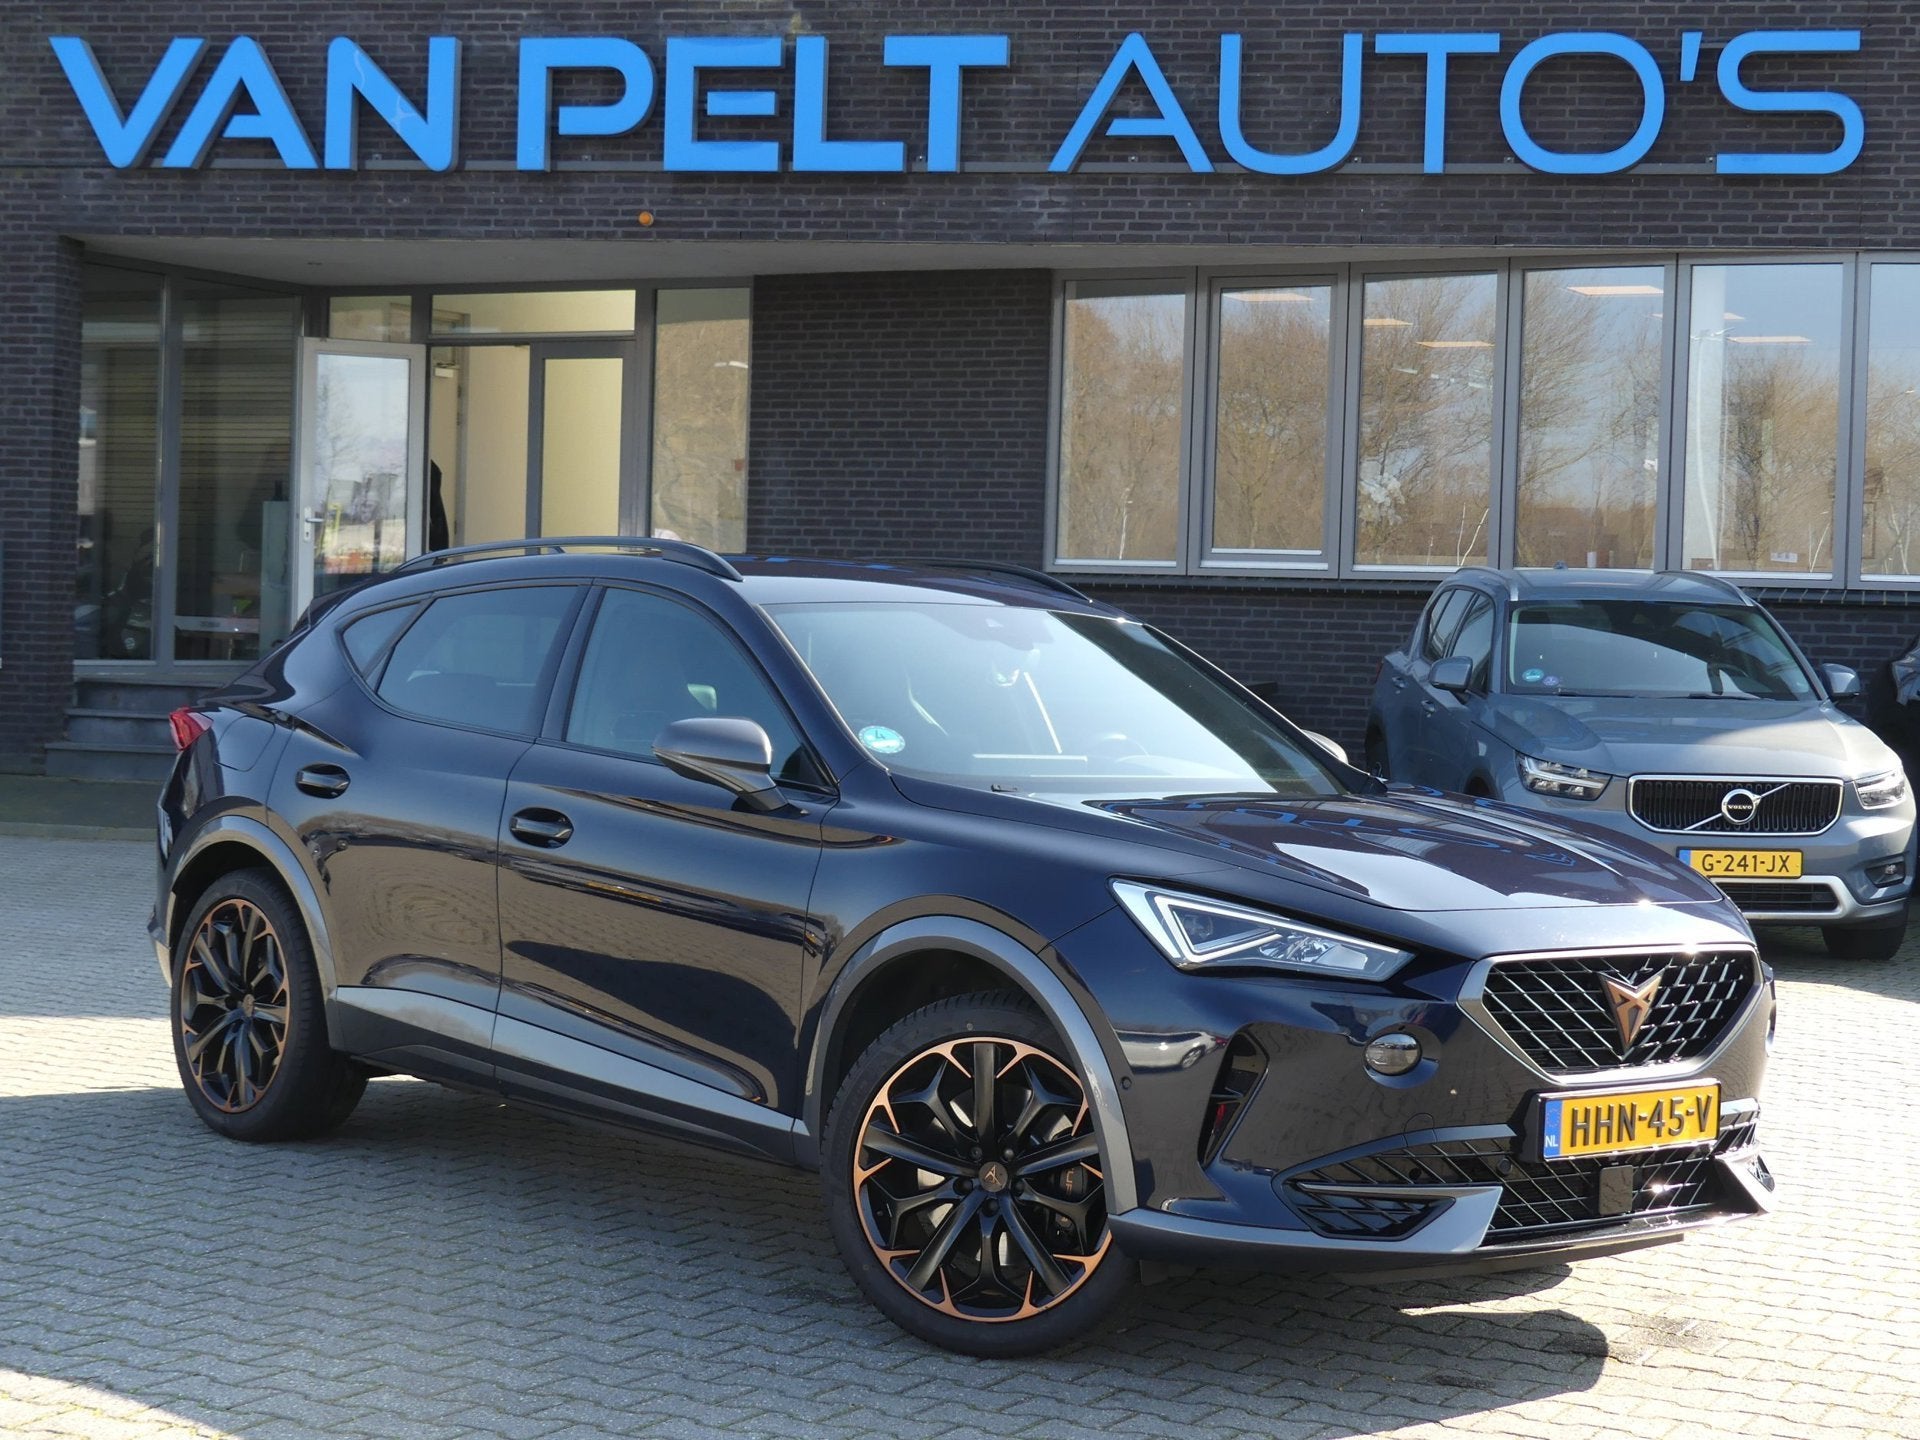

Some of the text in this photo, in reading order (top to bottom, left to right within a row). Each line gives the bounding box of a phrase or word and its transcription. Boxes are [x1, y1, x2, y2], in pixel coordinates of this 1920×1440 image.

[49, 30, 1865, 175] VAN PELT AUTO'S
[1701, 854, 1790, 873] G-241-JX
[1570, 1094, 1713, 1148] HHN-45-V
[1544, 1135, 1558, 1148] NL
